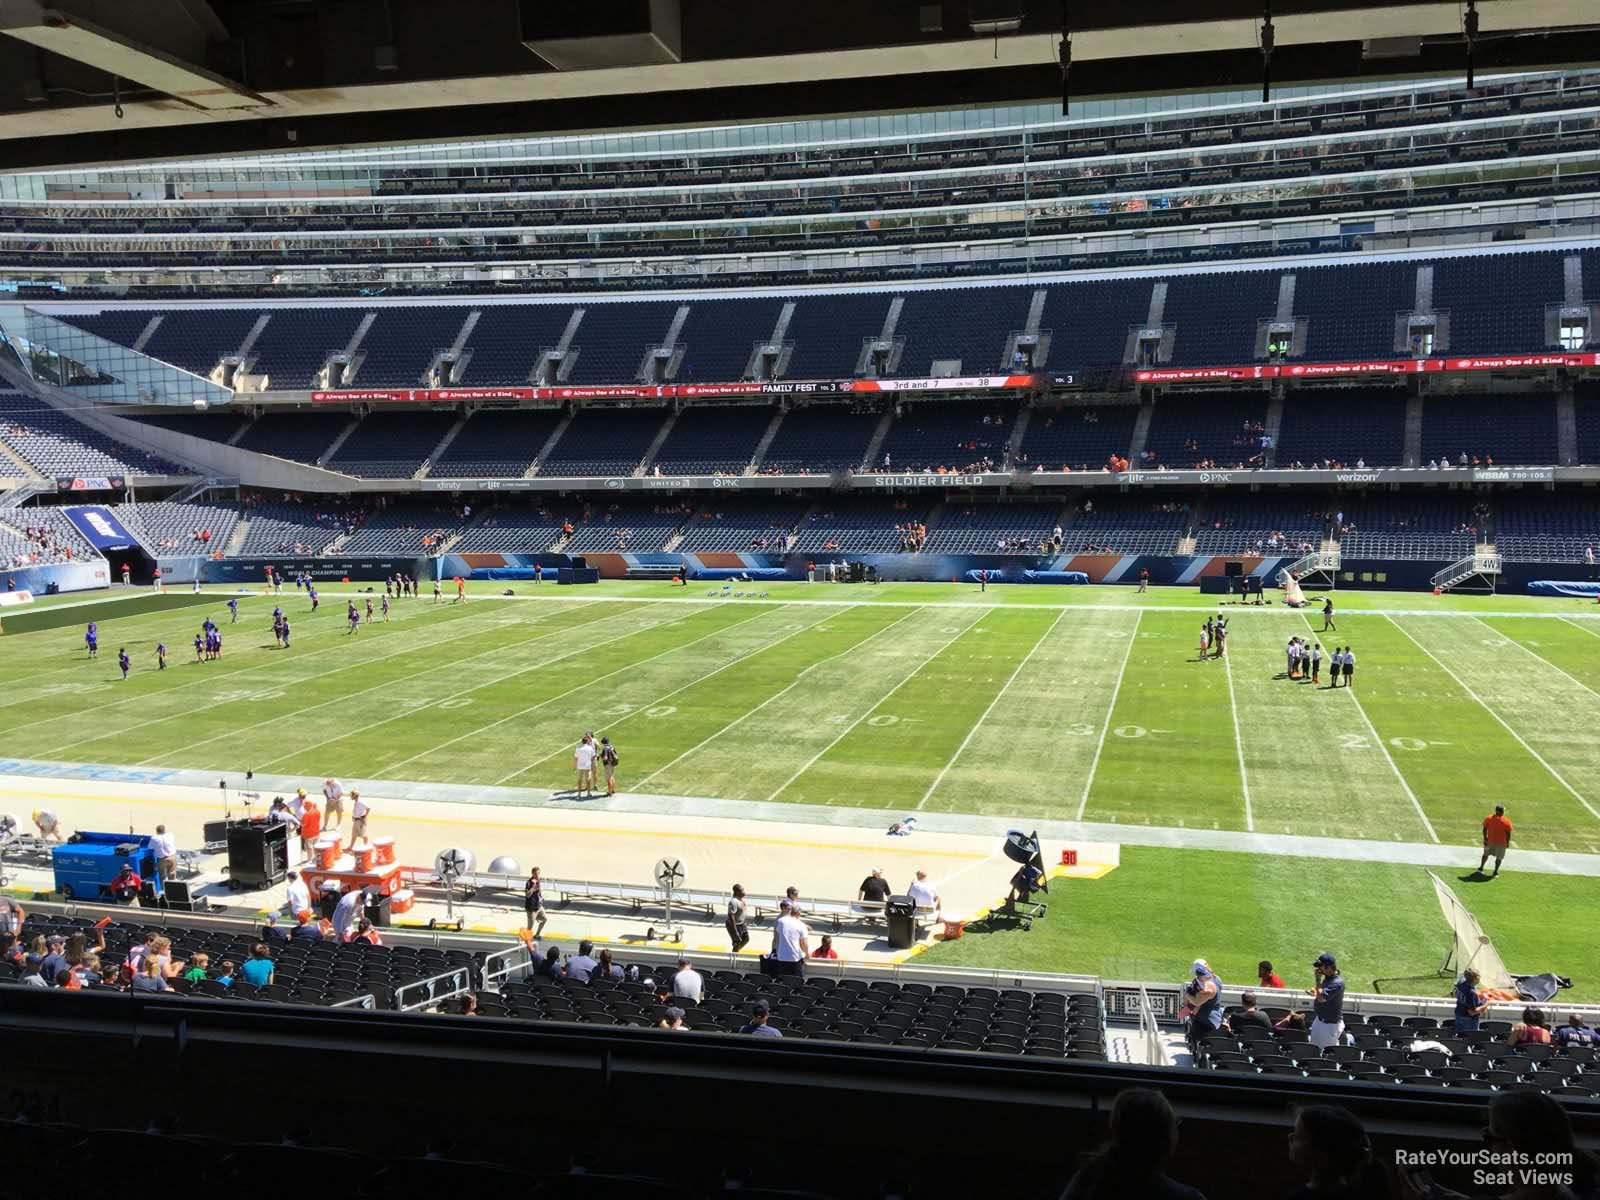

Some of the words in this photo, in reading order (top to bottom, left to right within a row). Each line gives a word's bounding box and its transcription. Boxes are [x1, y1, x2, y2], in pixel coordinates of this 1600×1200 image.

[762, 384, 793, 393] FAMILY
[795, 384, 817, 392] FEST
[830, 383, 836, 391] 3
[893, 381, 908, 389] 3rd
[911, 381, 928, 389] and
[933, 380, 939, 388] 7
[875, 476, 936, 486] SOLDIER
[941, 476, 983, 485] FIELD
[1211, 473, 1232, 481] PNC
[1337, 472, 1376, 481] verizon
[87, 479, 108, 488] PNC
[722, 479, 740, 487] PNC
[1483, 560, 1496, 568] 4W
